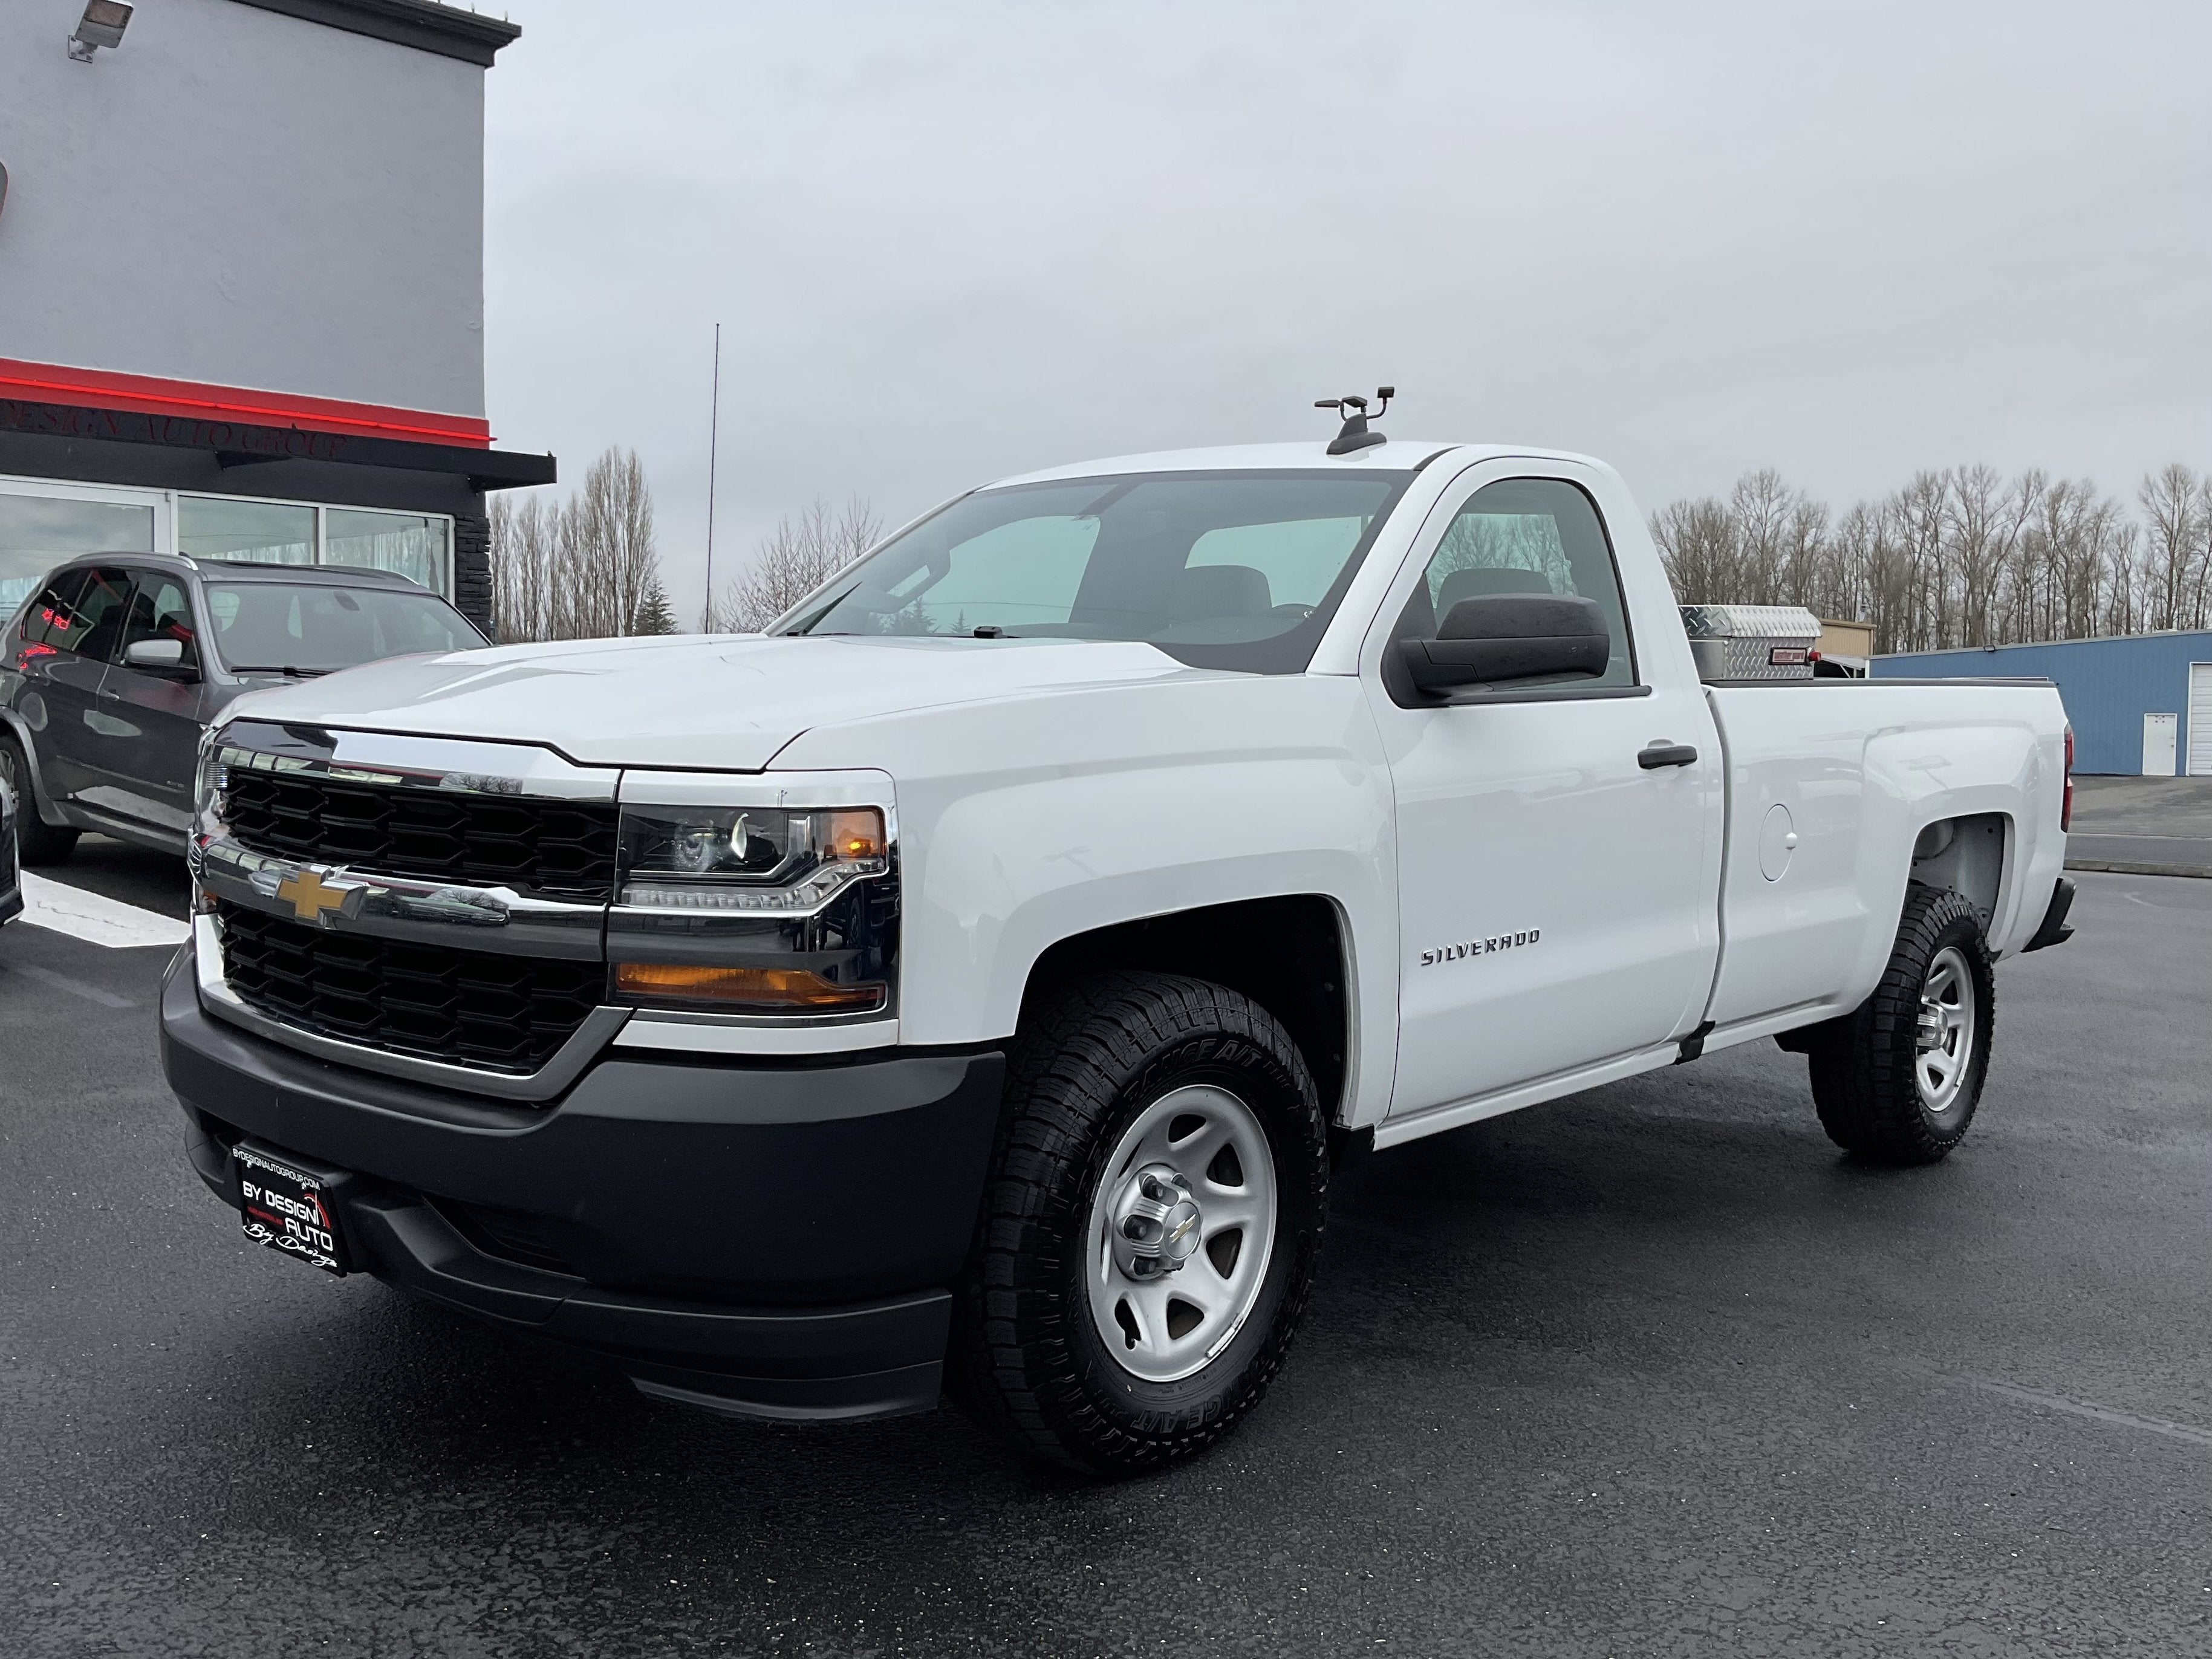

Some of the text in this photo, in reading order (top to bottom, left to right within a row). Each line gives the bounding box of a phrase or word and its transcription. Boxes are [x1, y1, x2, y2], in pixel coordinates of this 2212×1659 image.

[135, 415, 232, 446] AUTO
[242, 426, 348, 458] GROUP
[1421, 928, 1540, 966] SILVERADO
[242, 1181, 319, 1226] BY DESIGN
[242, 1223, 274, 1245] By
[285, 1217, 333, 1252] AUTO
